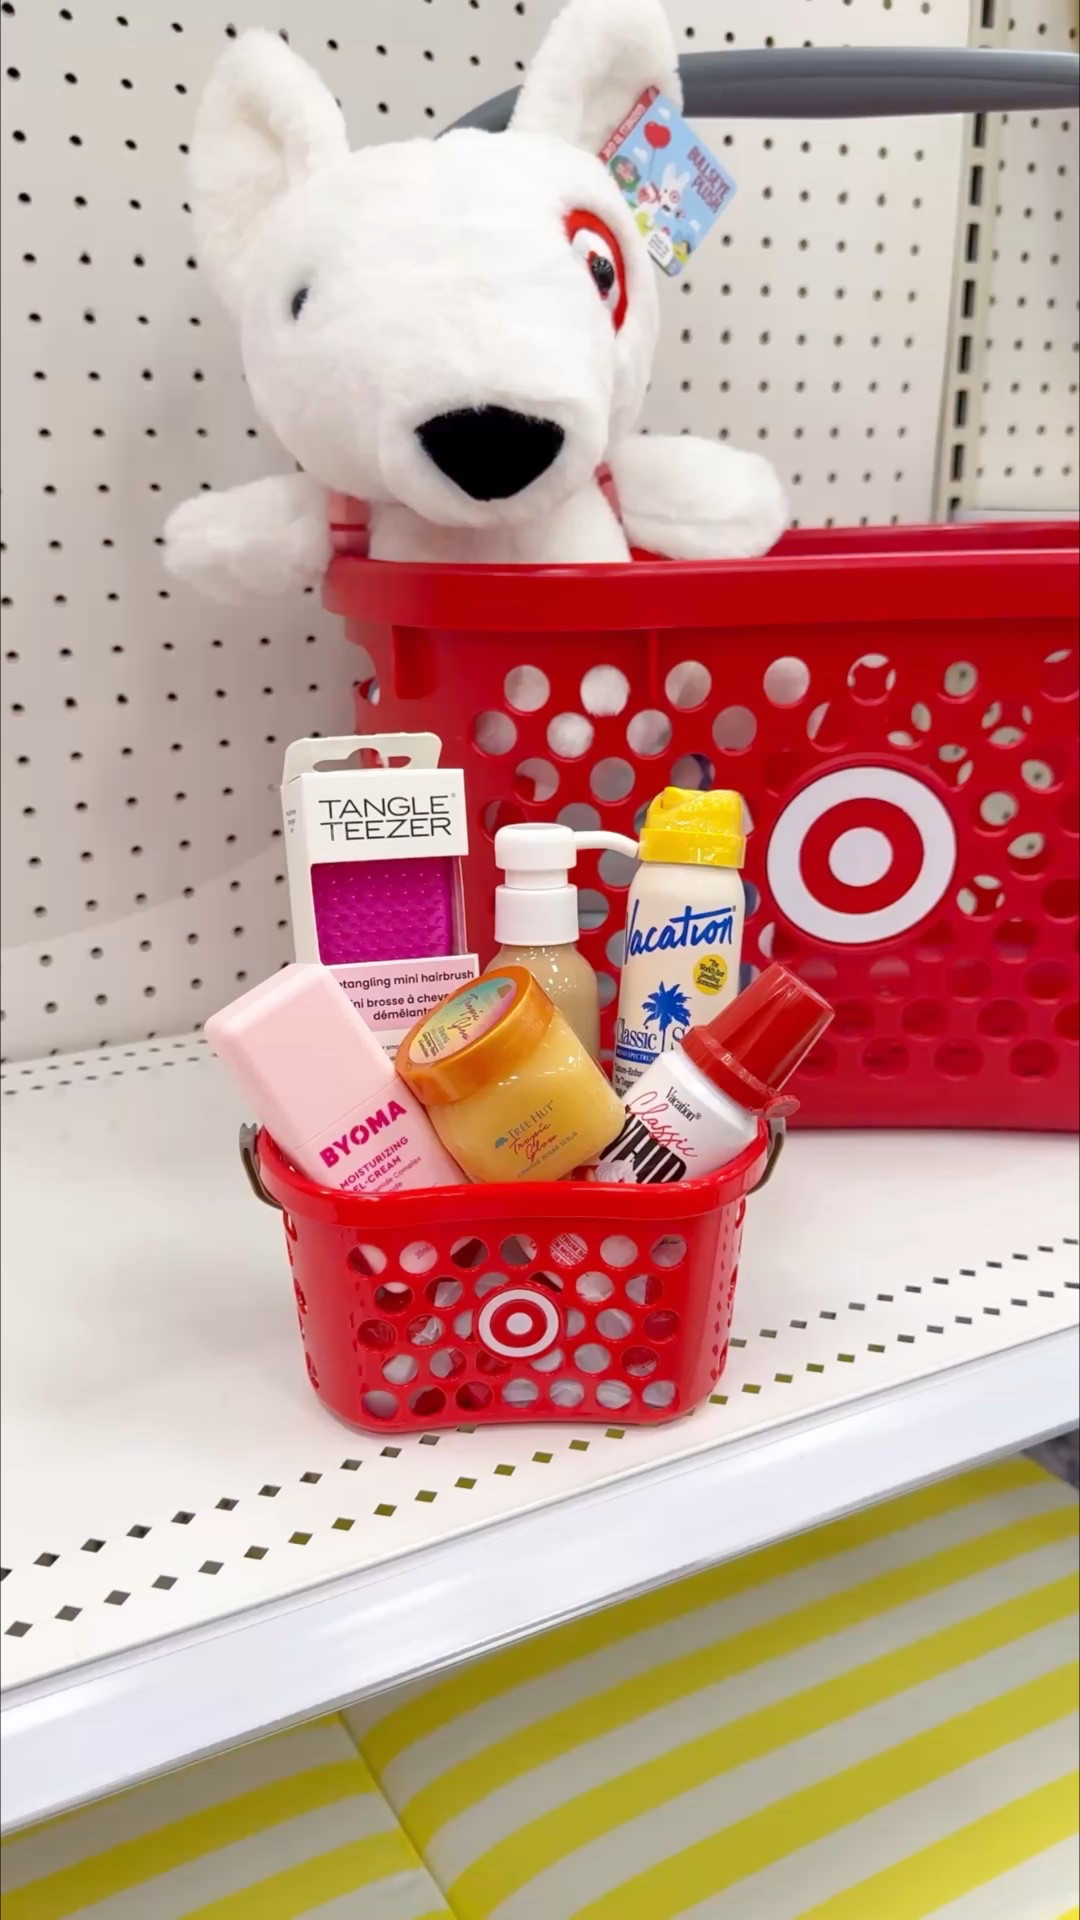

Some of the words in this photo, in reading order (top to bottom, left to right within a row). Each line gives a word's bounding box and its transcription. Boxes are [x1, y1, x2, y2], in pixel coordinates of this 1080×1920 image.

[318, 795, 449, 819] TANGLE
[319, 817, 452, 841] TEEZER
[624, 899, 733, 965] Vacation
[394, 974, 418, 985] mini
[421, 969, 474, 983] hairbrush
[367, 997, 404, 1008] brosse
[407, 994, 415, 1004] à
[373, 1007, 432, 1021] démêlant
[319, 1100, 407, 1168] BYOMA
[508, 1118, 533, 1140] TREE
[531, 1101, 556, 1124] HUT
[628, 1091, 698, 1157] Classic
[508, 1122, 551, 1154] Tropic
[524, 1134, 557, 1162] Glow
[339, 1136, 409, 1190] MOISTURIZING
[352, 1155, 402, 1192] EL-CREAM
[393, 1156, 422, 1179] Complex
